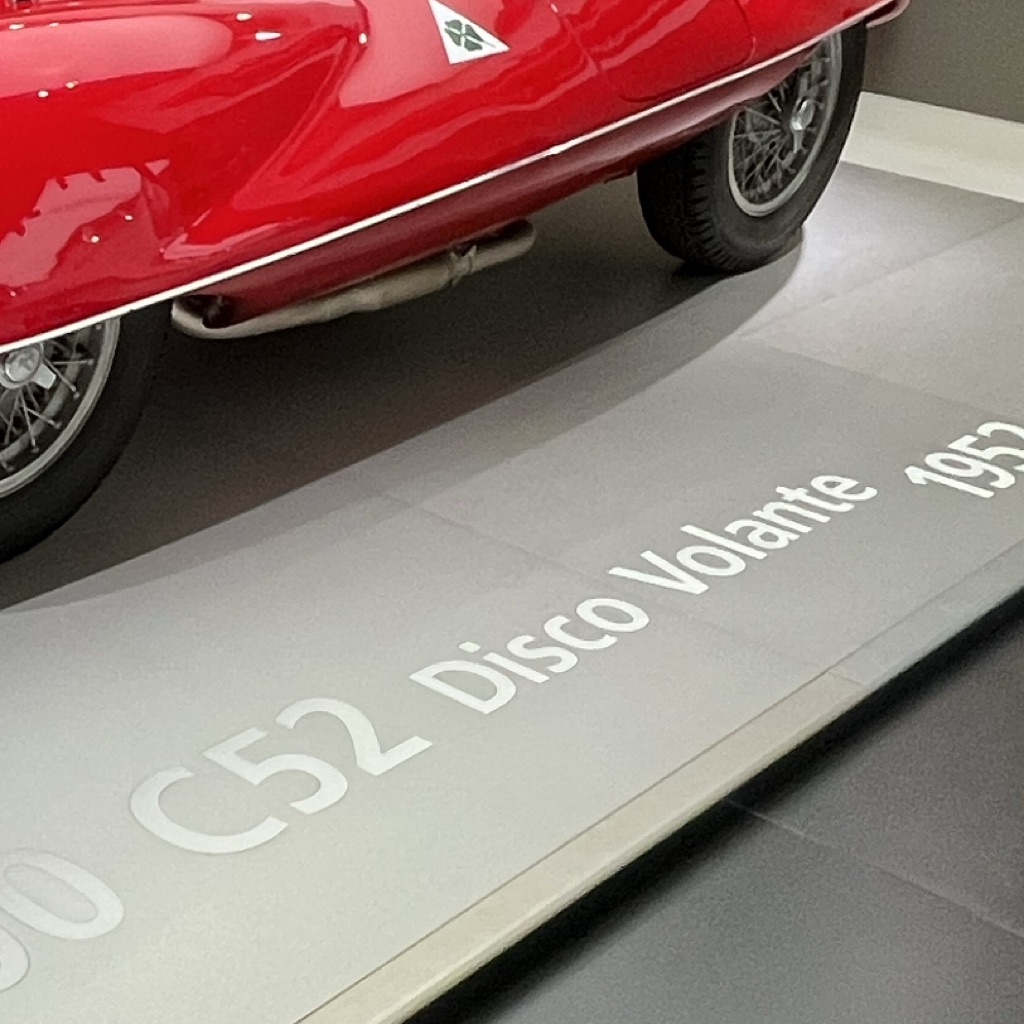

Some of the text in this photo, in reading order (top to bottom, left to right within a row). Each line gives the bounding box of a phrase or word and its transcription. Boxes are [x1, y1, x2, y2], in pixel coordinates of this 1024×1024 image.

[130, 698, 433, 854] C52
[410, 598, 650, 714] Disco
[609, 475, 878, 594] Volante
